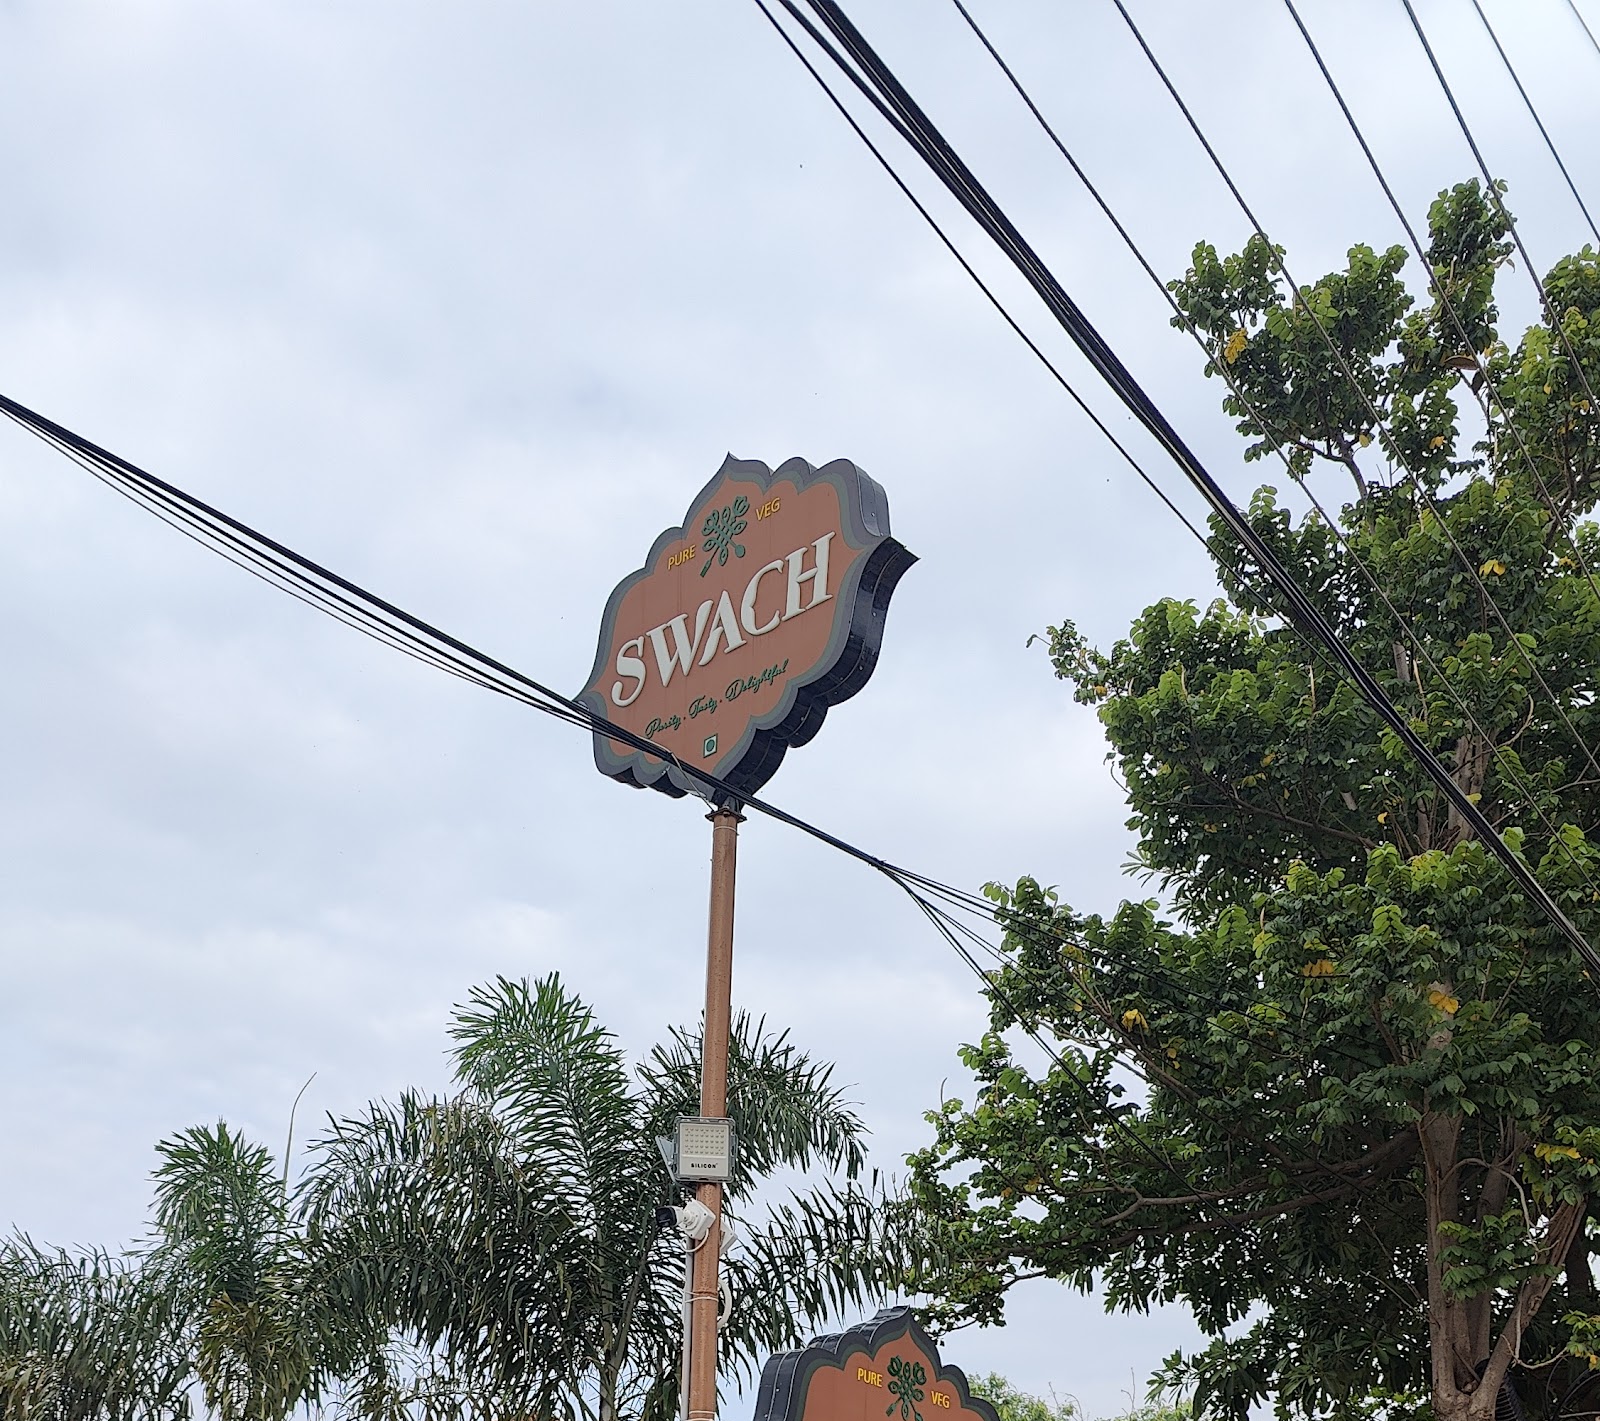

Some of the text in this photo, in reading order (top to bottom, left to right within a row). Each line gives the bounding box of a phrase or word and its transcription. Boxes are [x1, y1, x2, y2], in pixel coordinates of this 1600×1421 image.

[667, 497, 781, 570] PURE VEG
[611, 531, 836, 707] SWACH
[645, 659, 789, 739] Purity Tasty Delightful
[857, 1368, 950, 1409] PURE VEG
